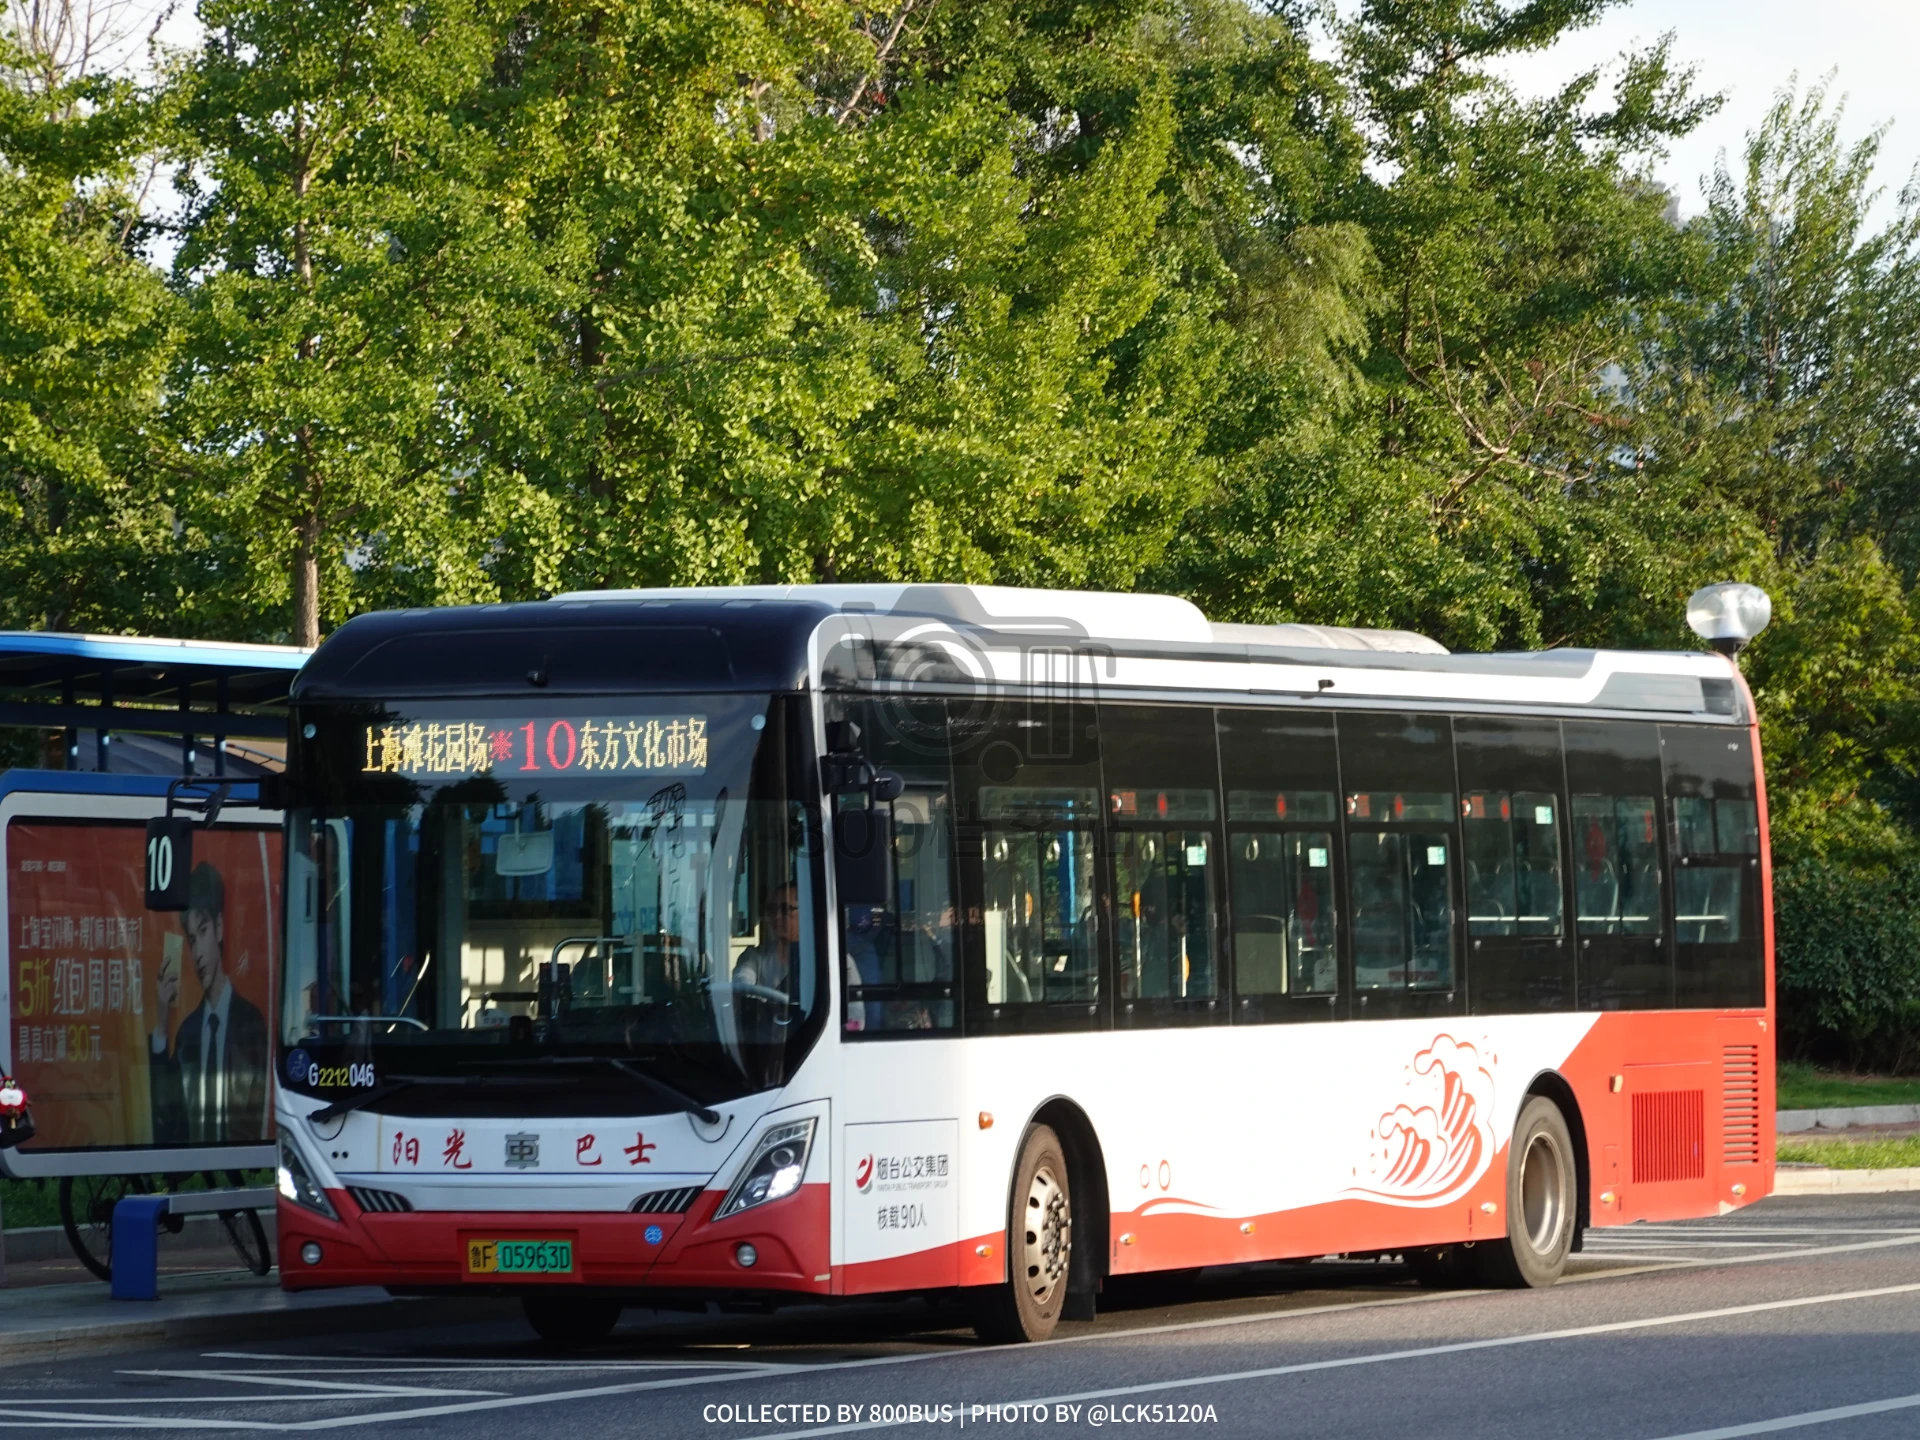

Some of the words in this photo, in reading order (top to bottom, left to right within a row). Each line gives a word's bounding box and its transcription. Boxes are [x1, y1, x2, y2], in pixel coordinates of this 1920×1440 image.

[519, 720, 577, 771] 10
[579, 718, 708, 770] 东方文化市场
[148, 837, 173, 892] 10
[308, 1062, 375, 1087] G2212046
[876, 1153, 949, 1181] 烟台公交集团
[877, 1203, 928, 1230] 核载90人
